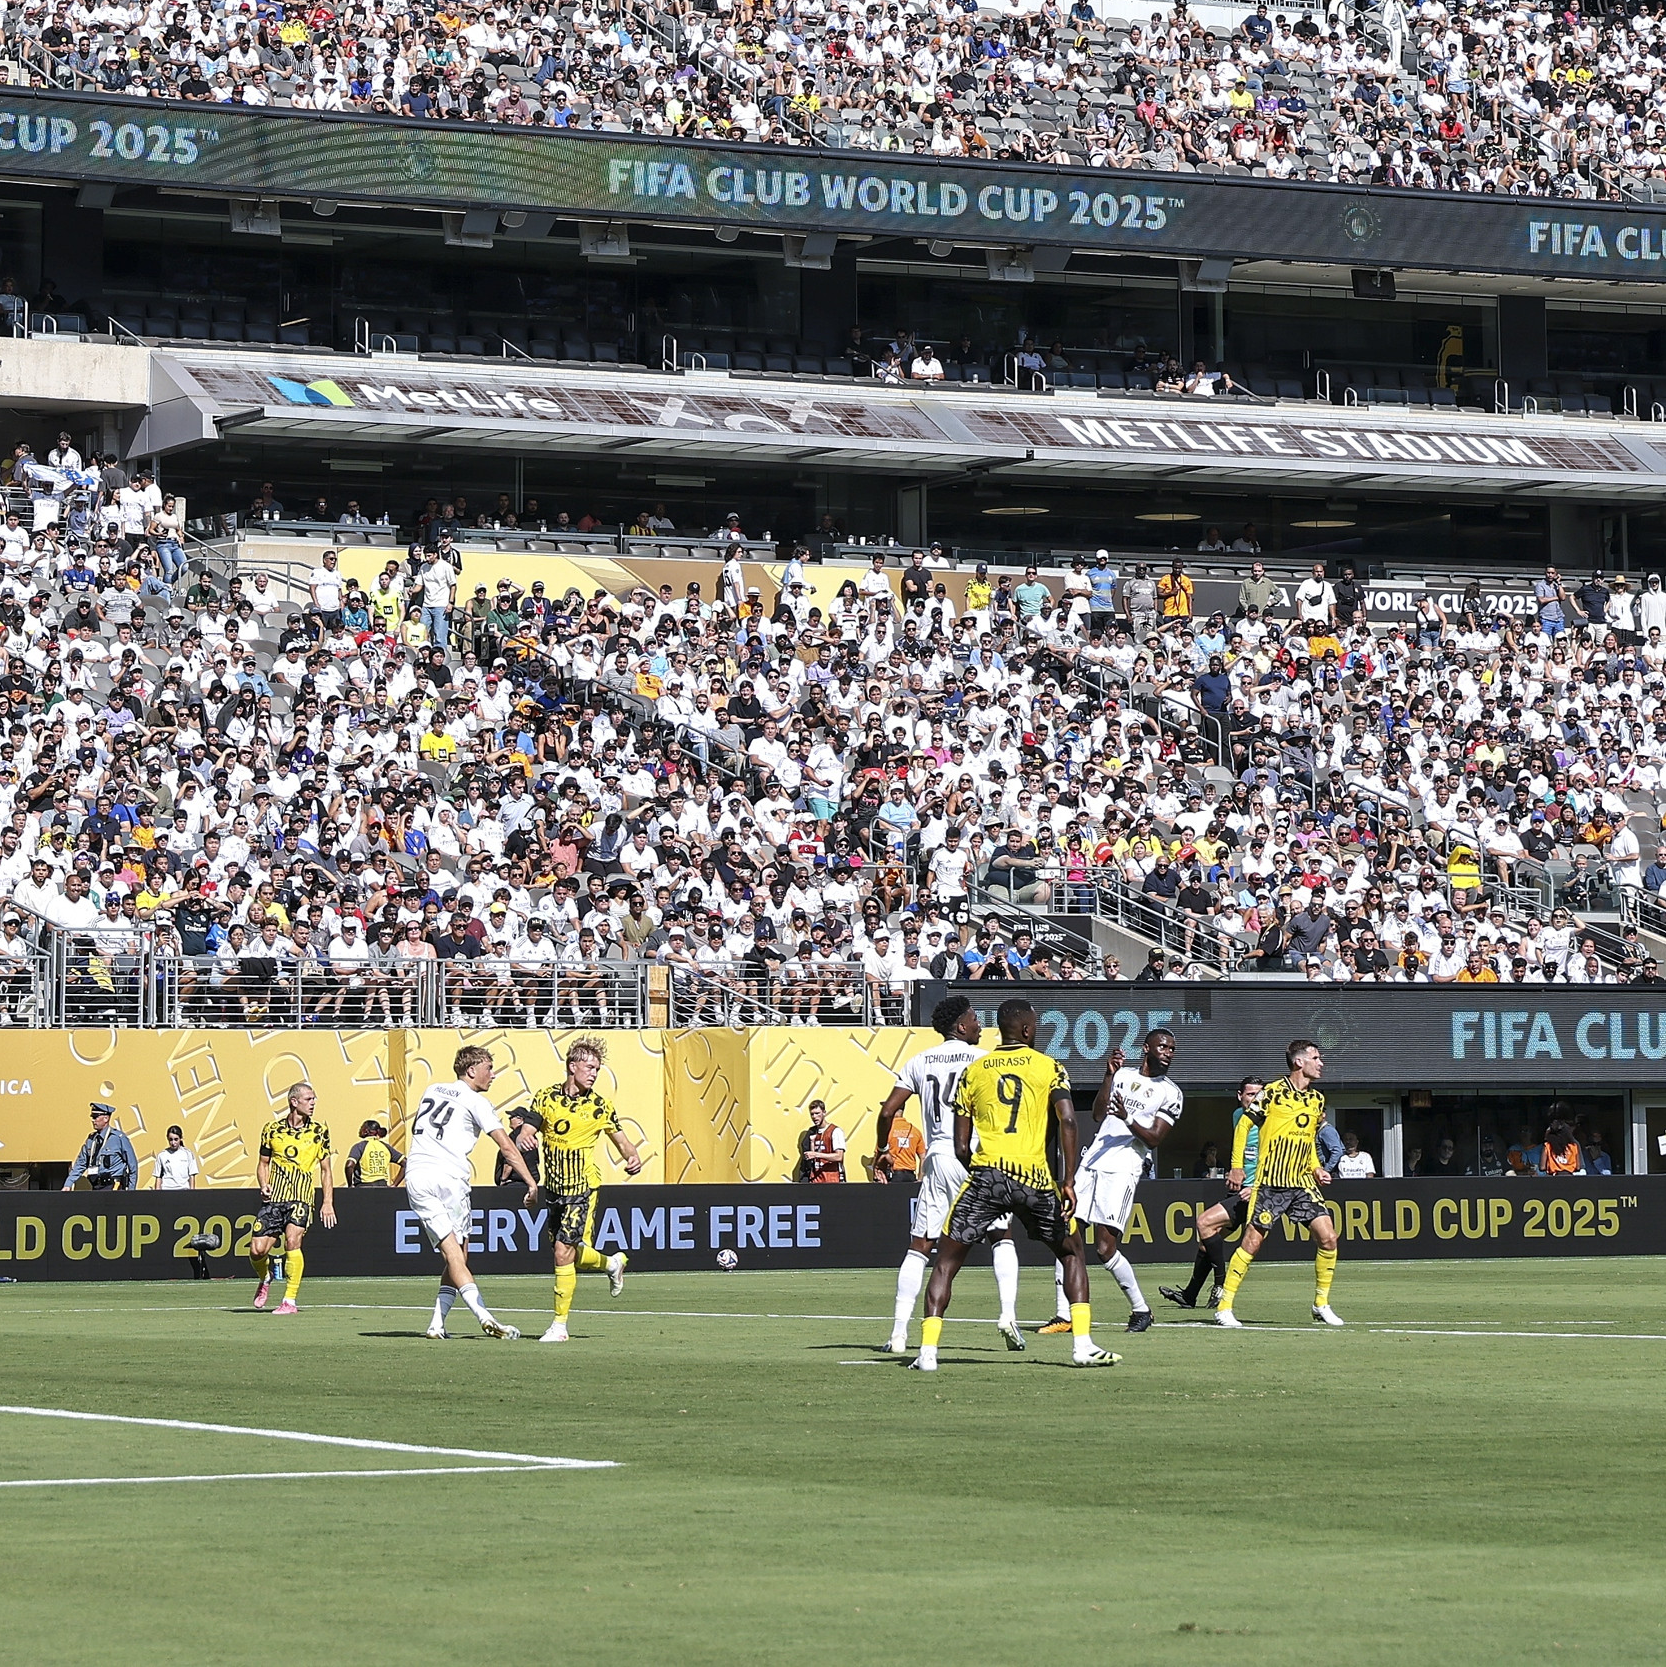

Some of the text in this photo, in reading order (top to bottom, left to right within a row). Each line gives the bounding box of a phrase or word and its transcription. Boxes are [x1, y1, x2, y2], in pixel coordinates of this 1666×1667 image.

[608, 159, 695, 201] FIFA
[706, 165, 810, 208] CLUB
[821, 175, 968, 218] WORLD
[978, 184, 1057, 224] CUP
[1529, 221, 1606, 259] FIFA
[357, 383, 563, 413] MetLife
[1057, 417, 1546, 465] METLIFE STADIUM
[1440, 594, 1467, 613] CU
[1487, 595, 1538, 615] 2025
[1450, 1010, 1563, 1060] FIFA
[925, 1053, 975, 1064] TCHOUAMENI
[983, 1056, 1032, 1069] GUIRASSY
[412, 1098, 454, 1139] 24
[997, 1073, 1023, 1133] 9
[290, 1203, 305, 1217] 26
[395, 1205, 821, 1253] EERY AME FREE
[1433, 1199, 1511, 1239] CUP
[61, 1215, 160, 1259] CUP
